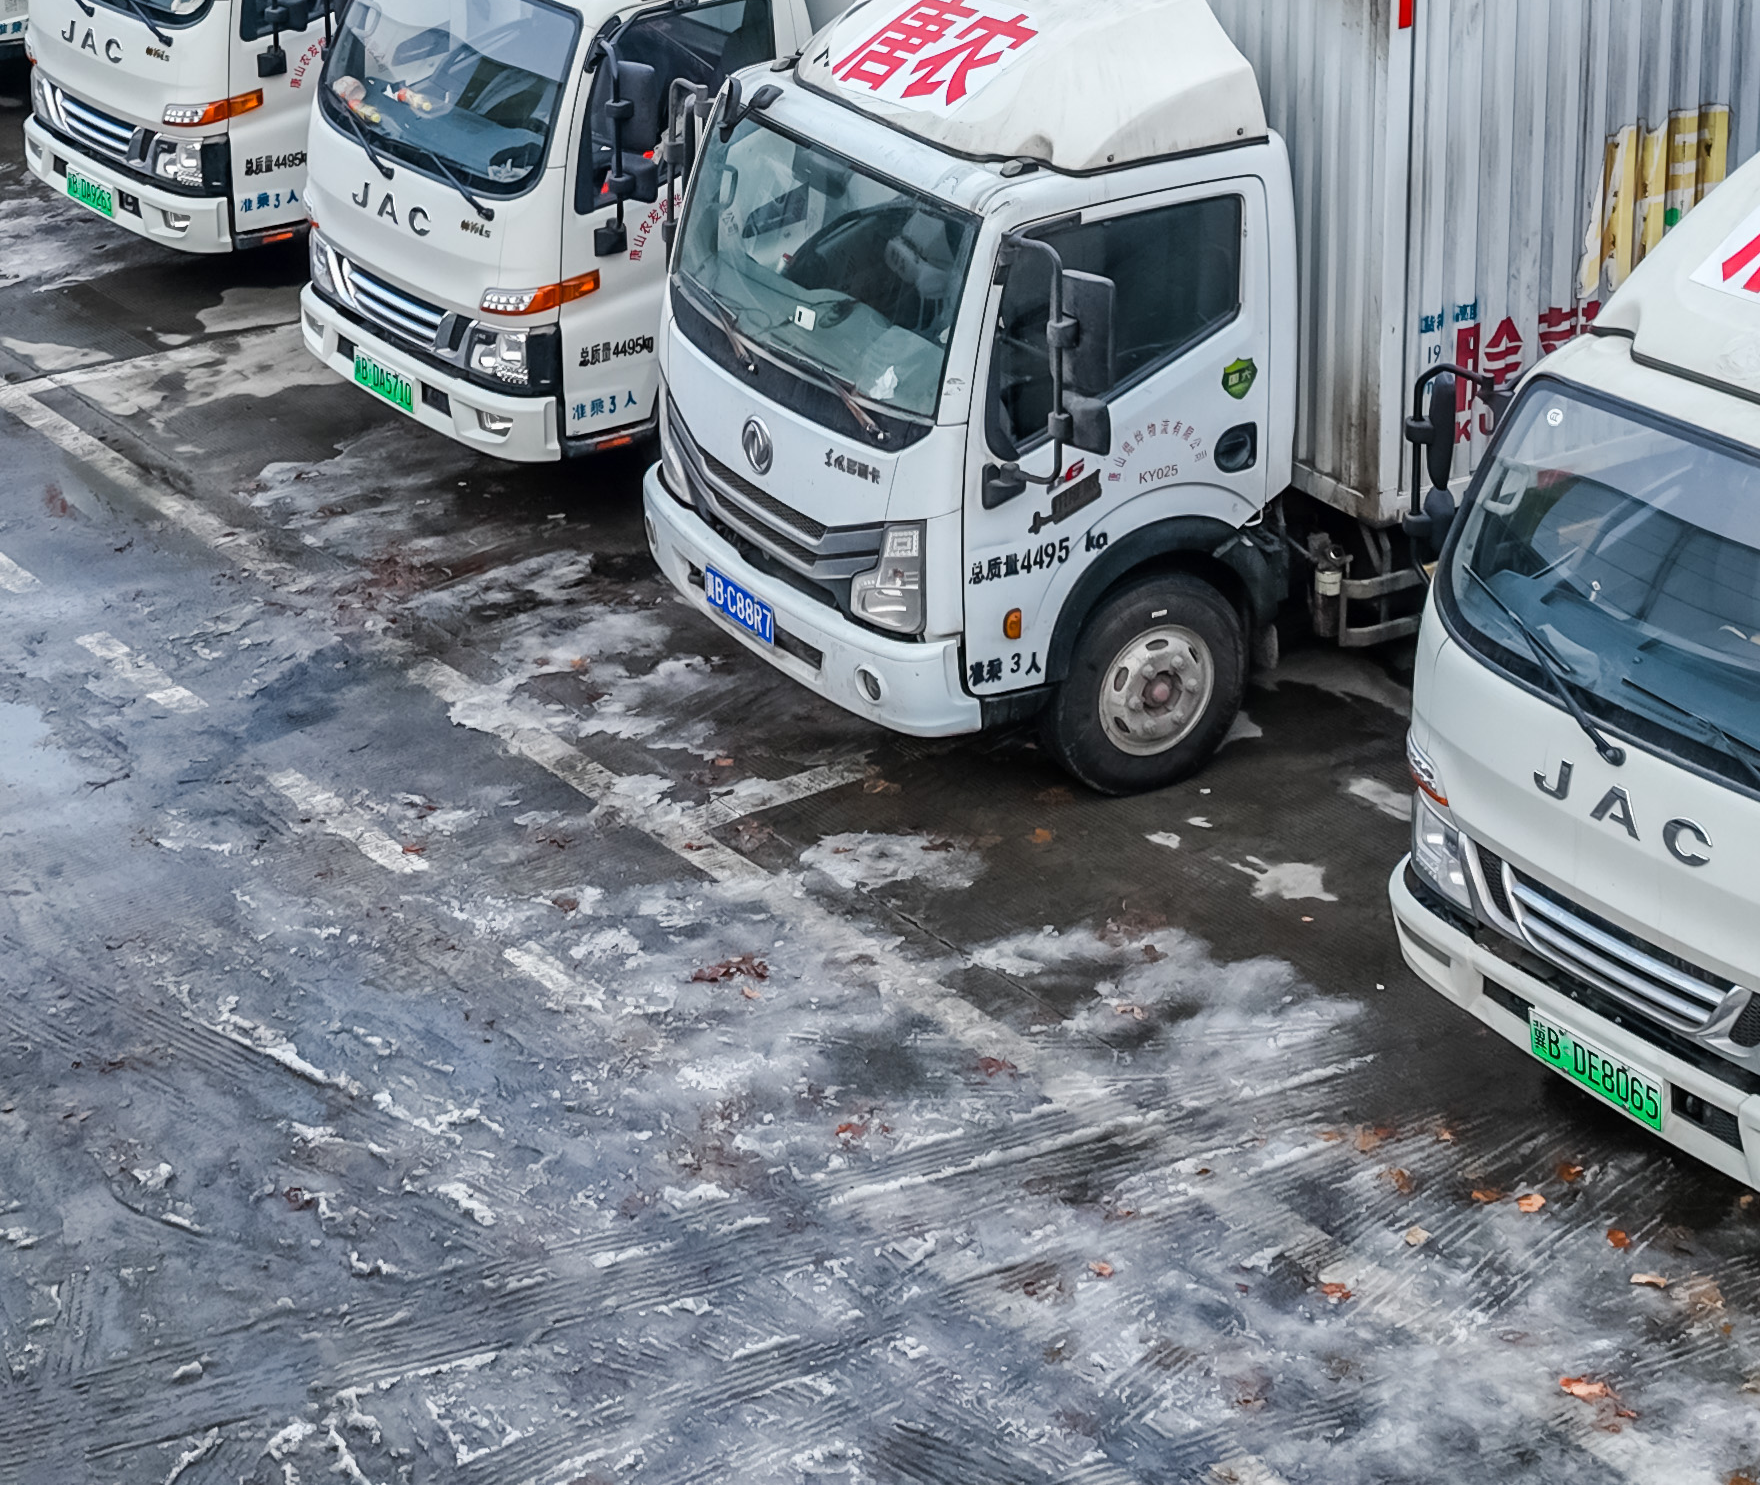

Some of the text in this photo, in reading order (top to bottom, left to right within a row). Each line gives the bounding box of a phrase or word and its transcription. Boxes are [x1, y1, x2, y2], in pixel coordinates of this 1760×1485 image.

[61, 19, 123, 64] JAC
[351, 179, 432, 237] JAC
[1139, 464, 1180, 485] KY025
[1533, 757, 1714, 868] JAC
